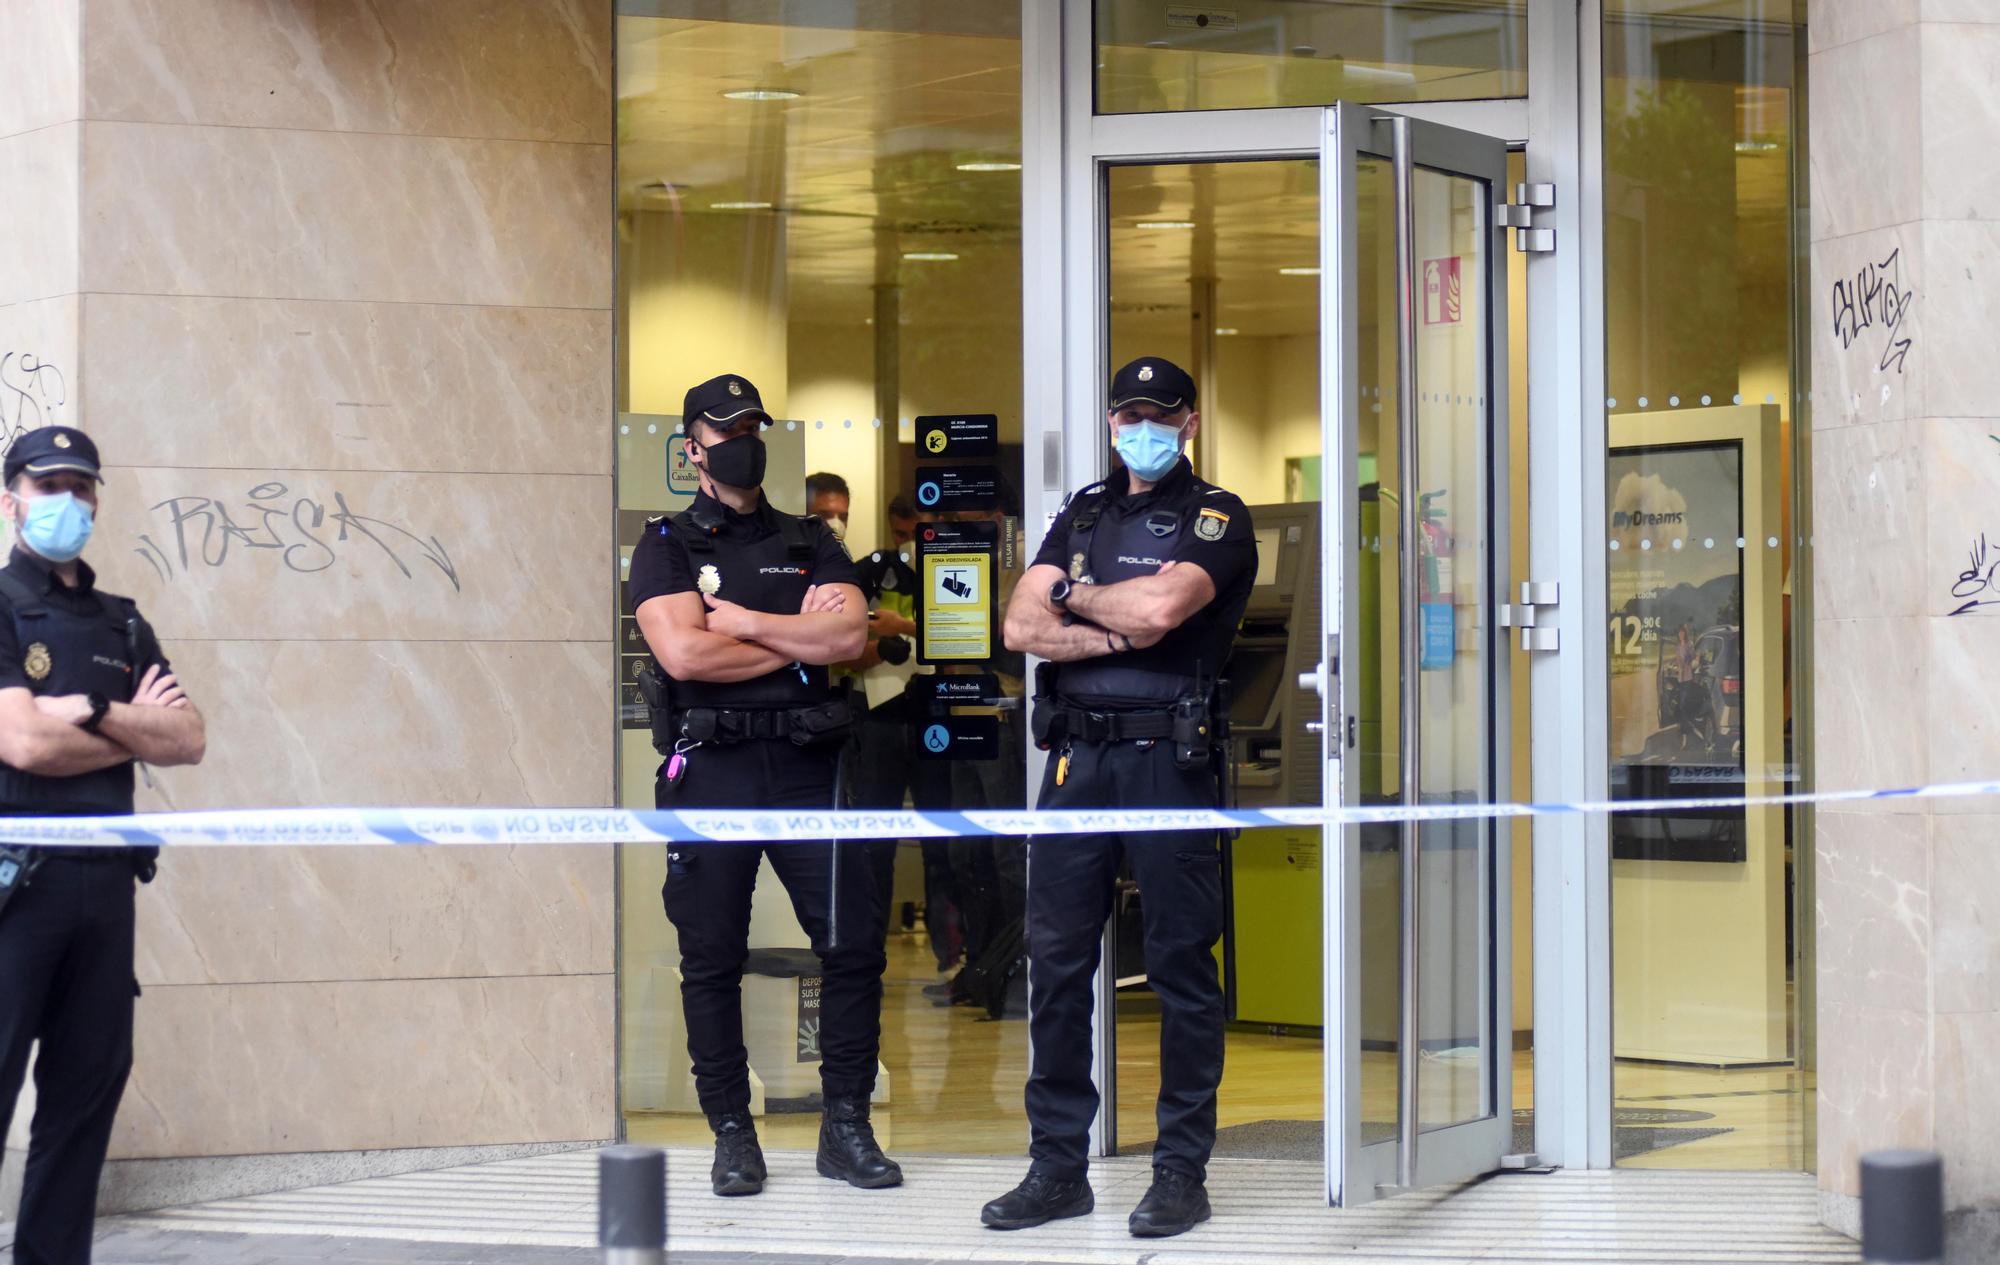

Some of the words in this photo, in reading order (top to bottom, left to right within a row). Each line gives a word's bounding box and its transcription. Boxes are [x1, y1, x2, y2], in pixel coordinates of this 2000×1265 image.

[671, 471, 700, 481] CaixaBan
[1118, 556, 1162, 565] POLICIA
[949, 683, 980, 691] MicroBank
[803, 977, 822, 986] DEPOS
[801, 989, 813, 998] SUS
[803, 999, 820, 1008] MASC
